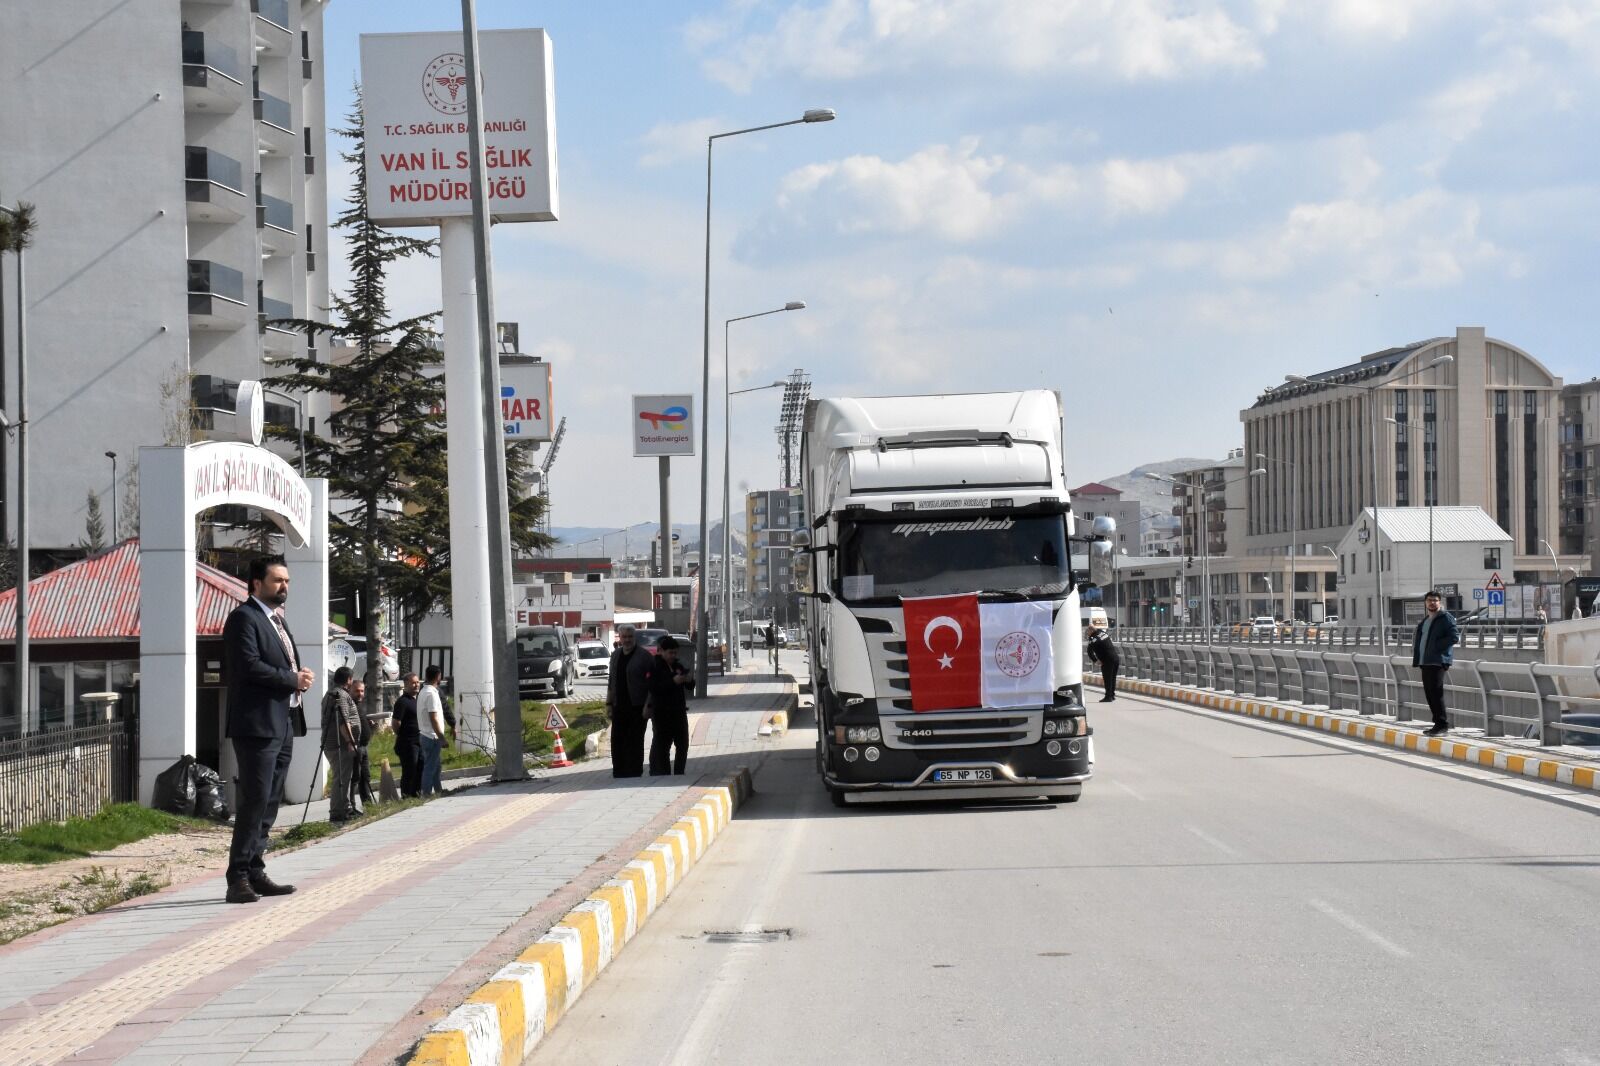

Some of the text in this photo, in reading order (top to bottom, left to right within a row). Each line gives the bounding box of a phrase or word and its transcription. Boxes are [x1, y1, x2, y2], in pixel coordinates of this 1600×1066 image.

[384, 118, 526, 136] T.C. SAĞLIK BANLIĞI
[381, 145, 532, 172] VAN İL SĞLIK
[390, 176, 526, 202] MÜDÜRĞÜ
[639, 434, 689, 444] TotalEnergies
[223, 452, 260, 494] SAĞLIK
[911, 729, 932, 737] 440
[940, 770, 991, 780] 65 NP 126
